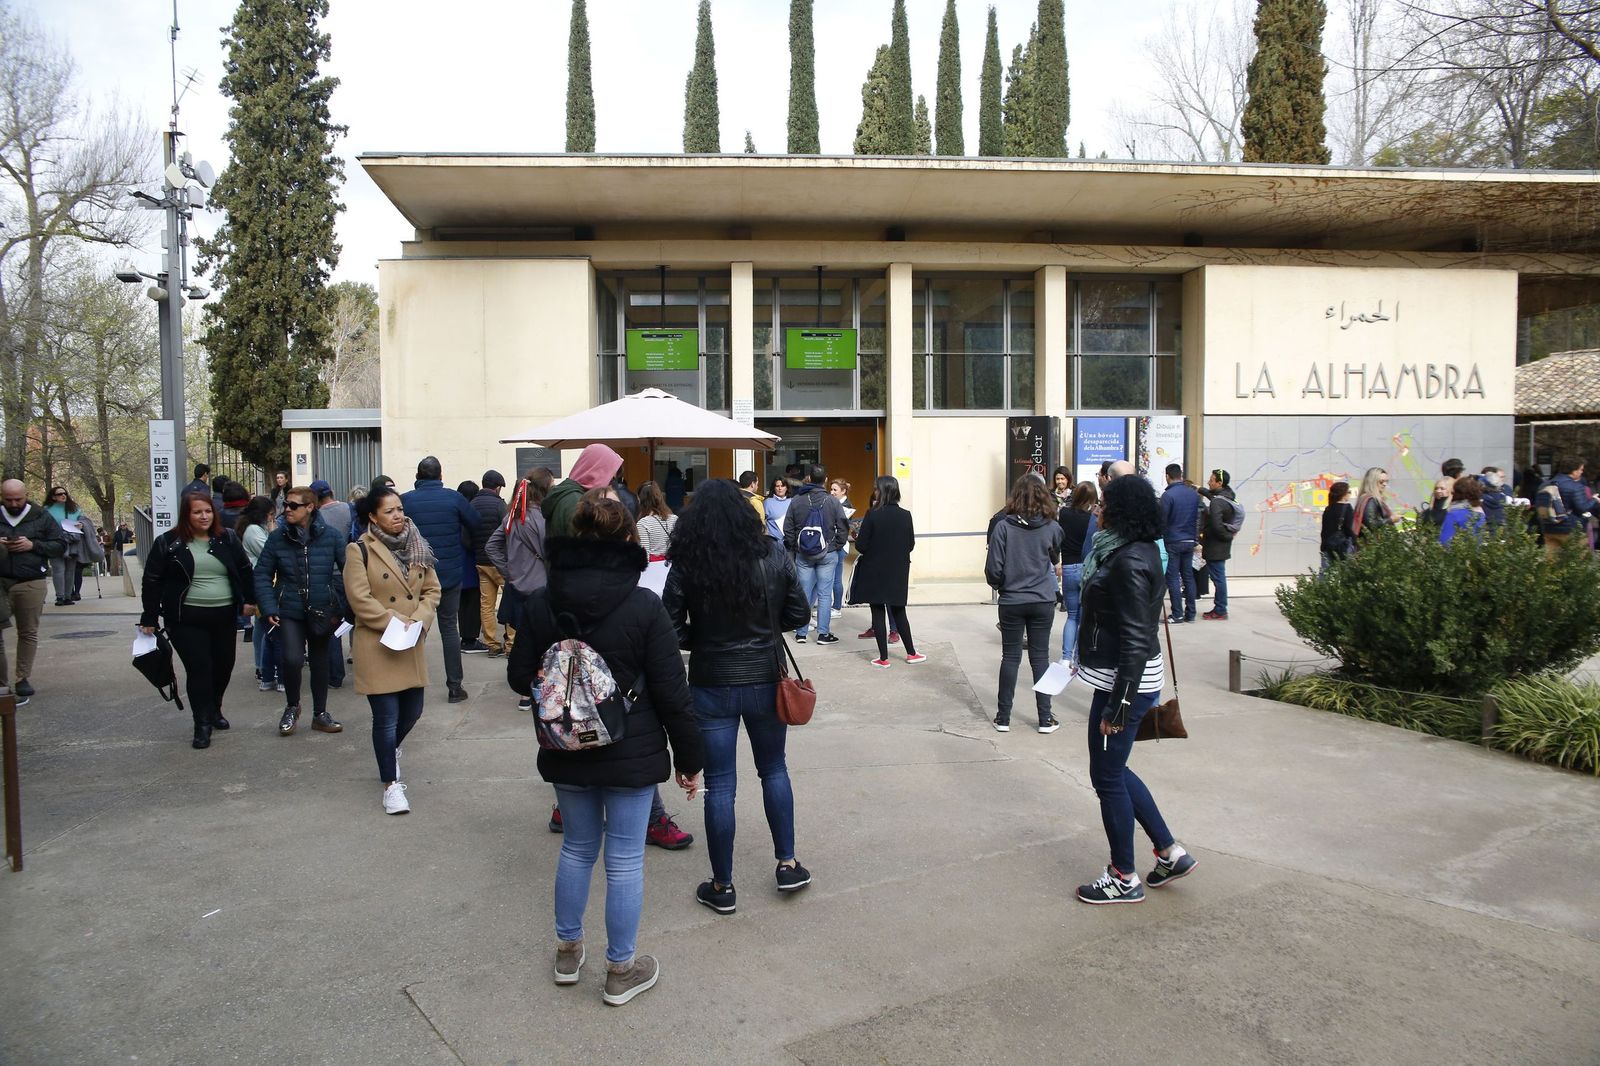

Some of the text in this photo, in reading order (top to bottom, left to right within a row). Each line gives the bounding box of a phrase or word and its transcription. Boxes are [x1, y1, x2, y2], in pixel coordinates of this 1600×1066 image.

[1325, 300, 1400, 330] الحمراء
[1235, 361, 1486, 399] LA ALHAMBRA
